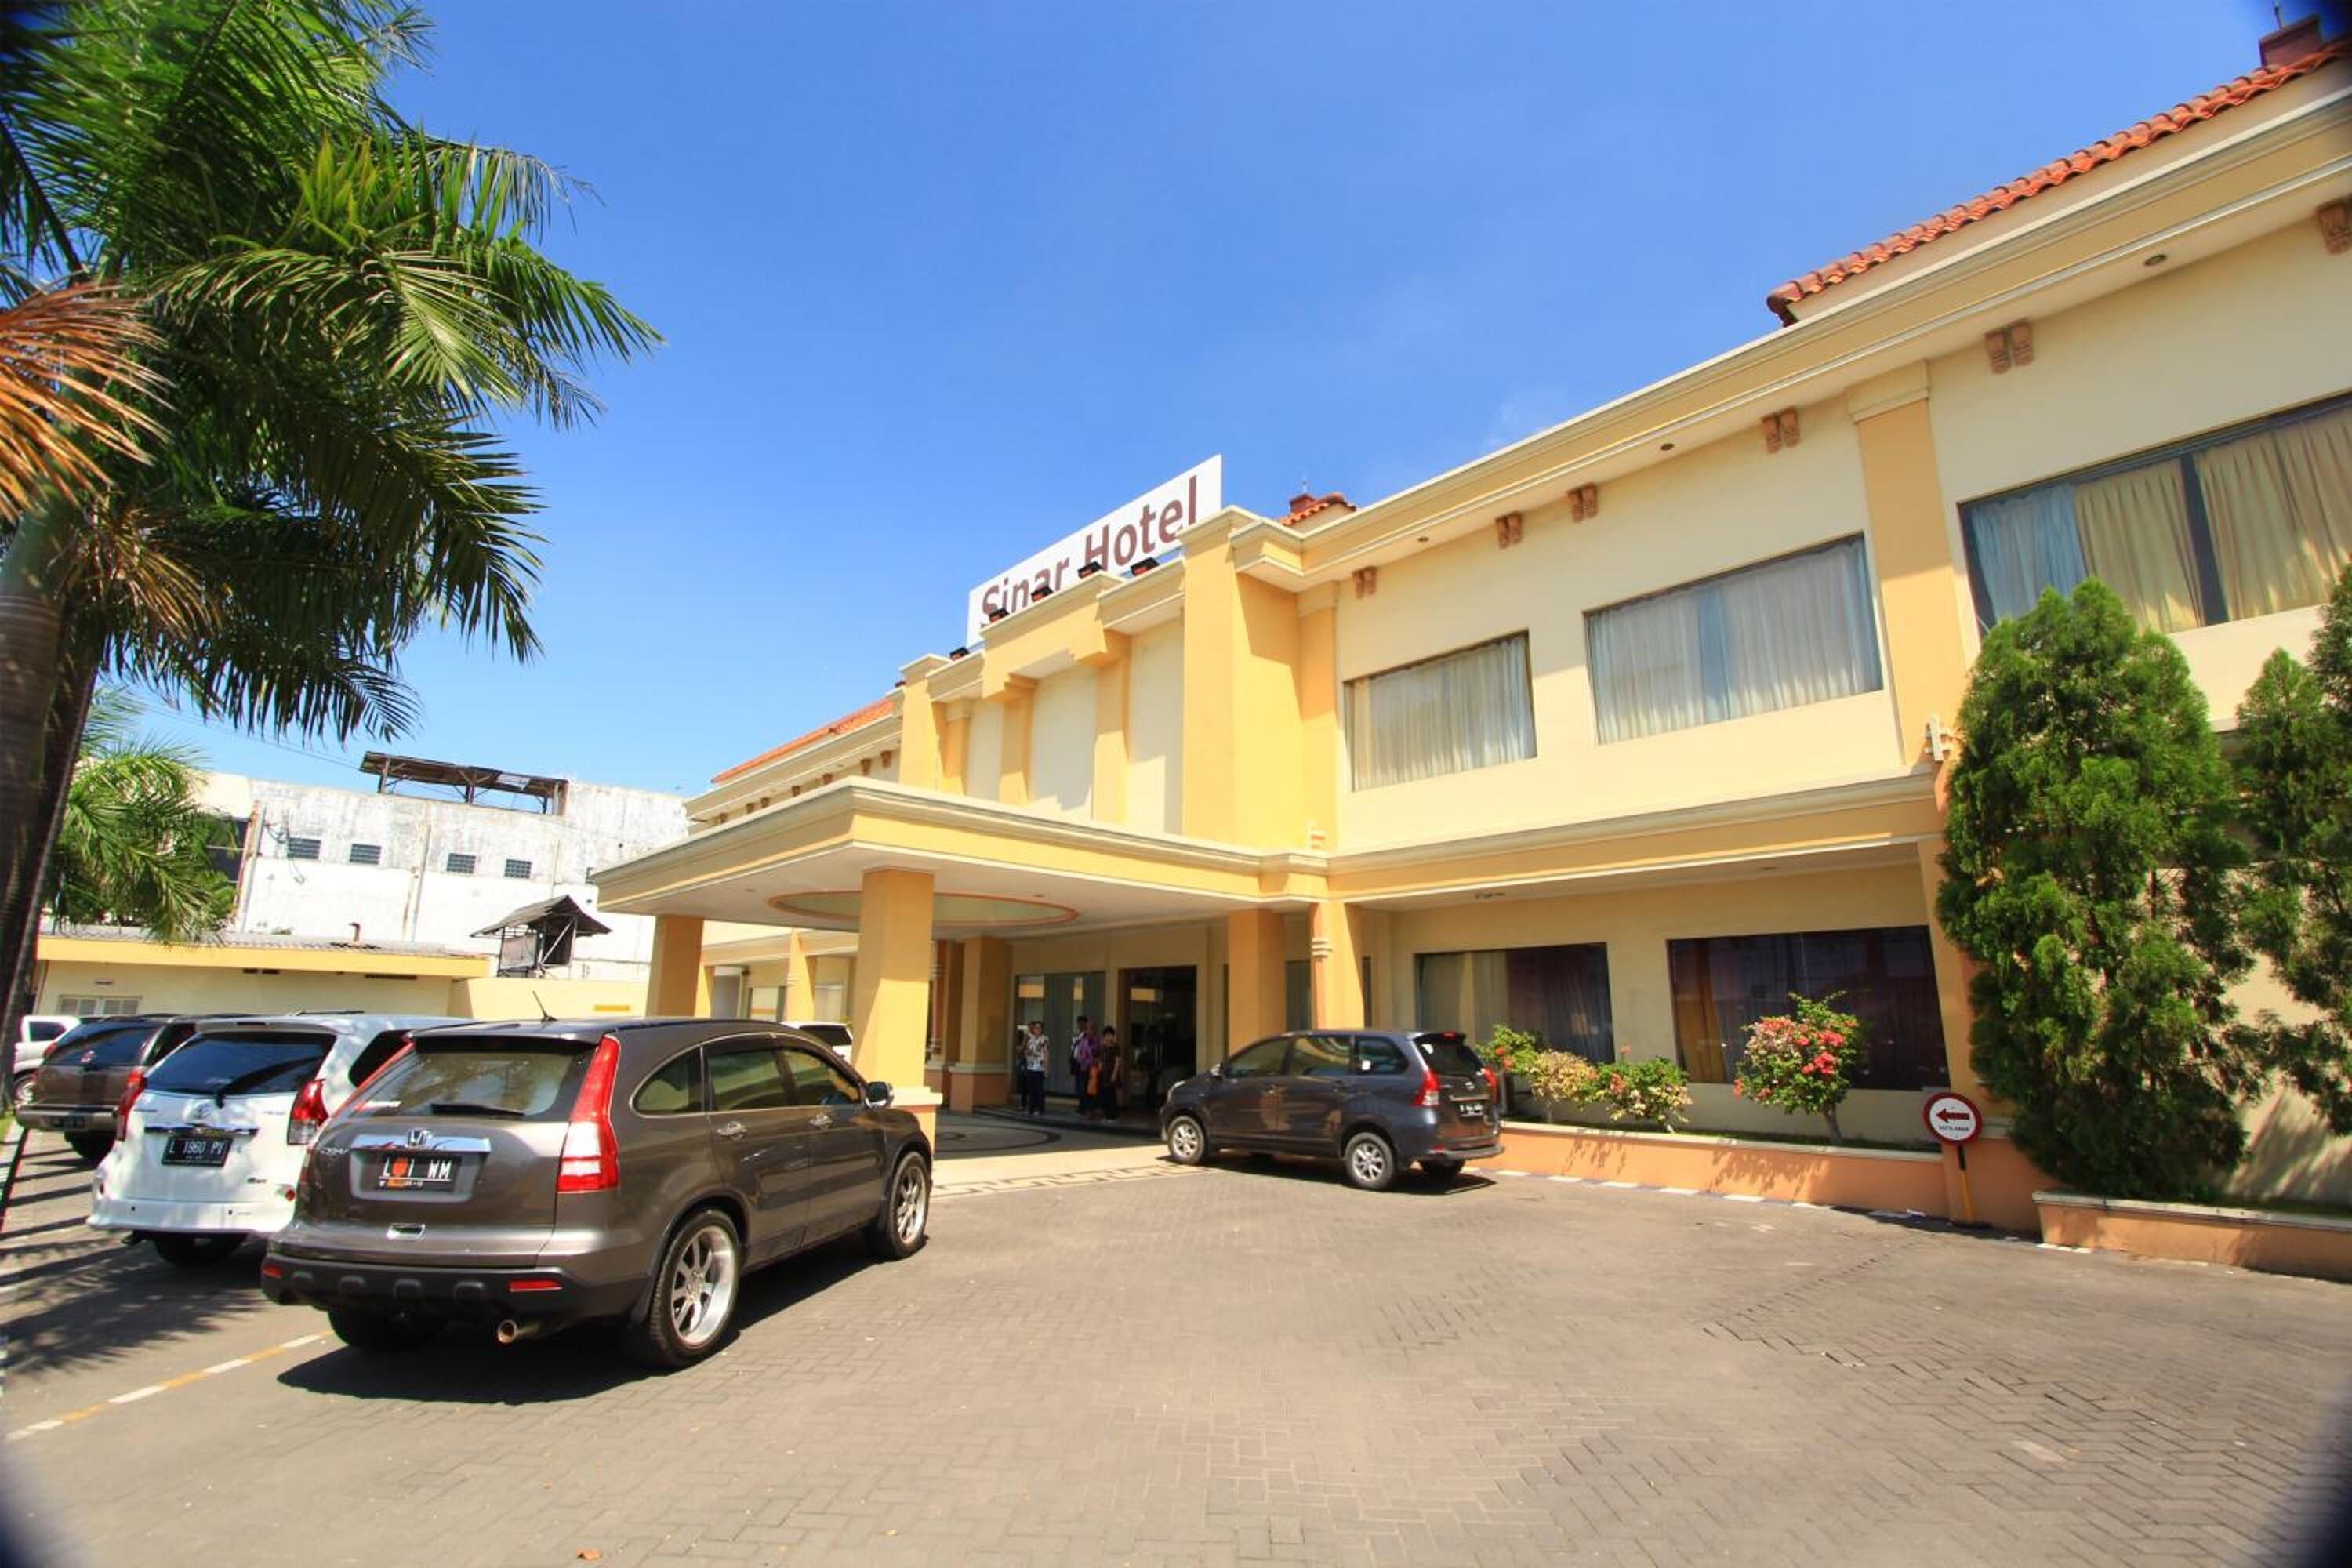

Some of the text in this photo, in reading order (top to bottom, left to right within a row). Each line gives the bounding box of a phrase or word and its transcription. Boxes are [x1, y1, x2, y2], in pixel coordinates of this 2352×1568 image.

[982, 475, 1197, 629] Sinar Hotel
[169, 1141, 176, 1153] L
[382, 1157, 390, 1177] L
[427, 1159, 452, 1179] WM
